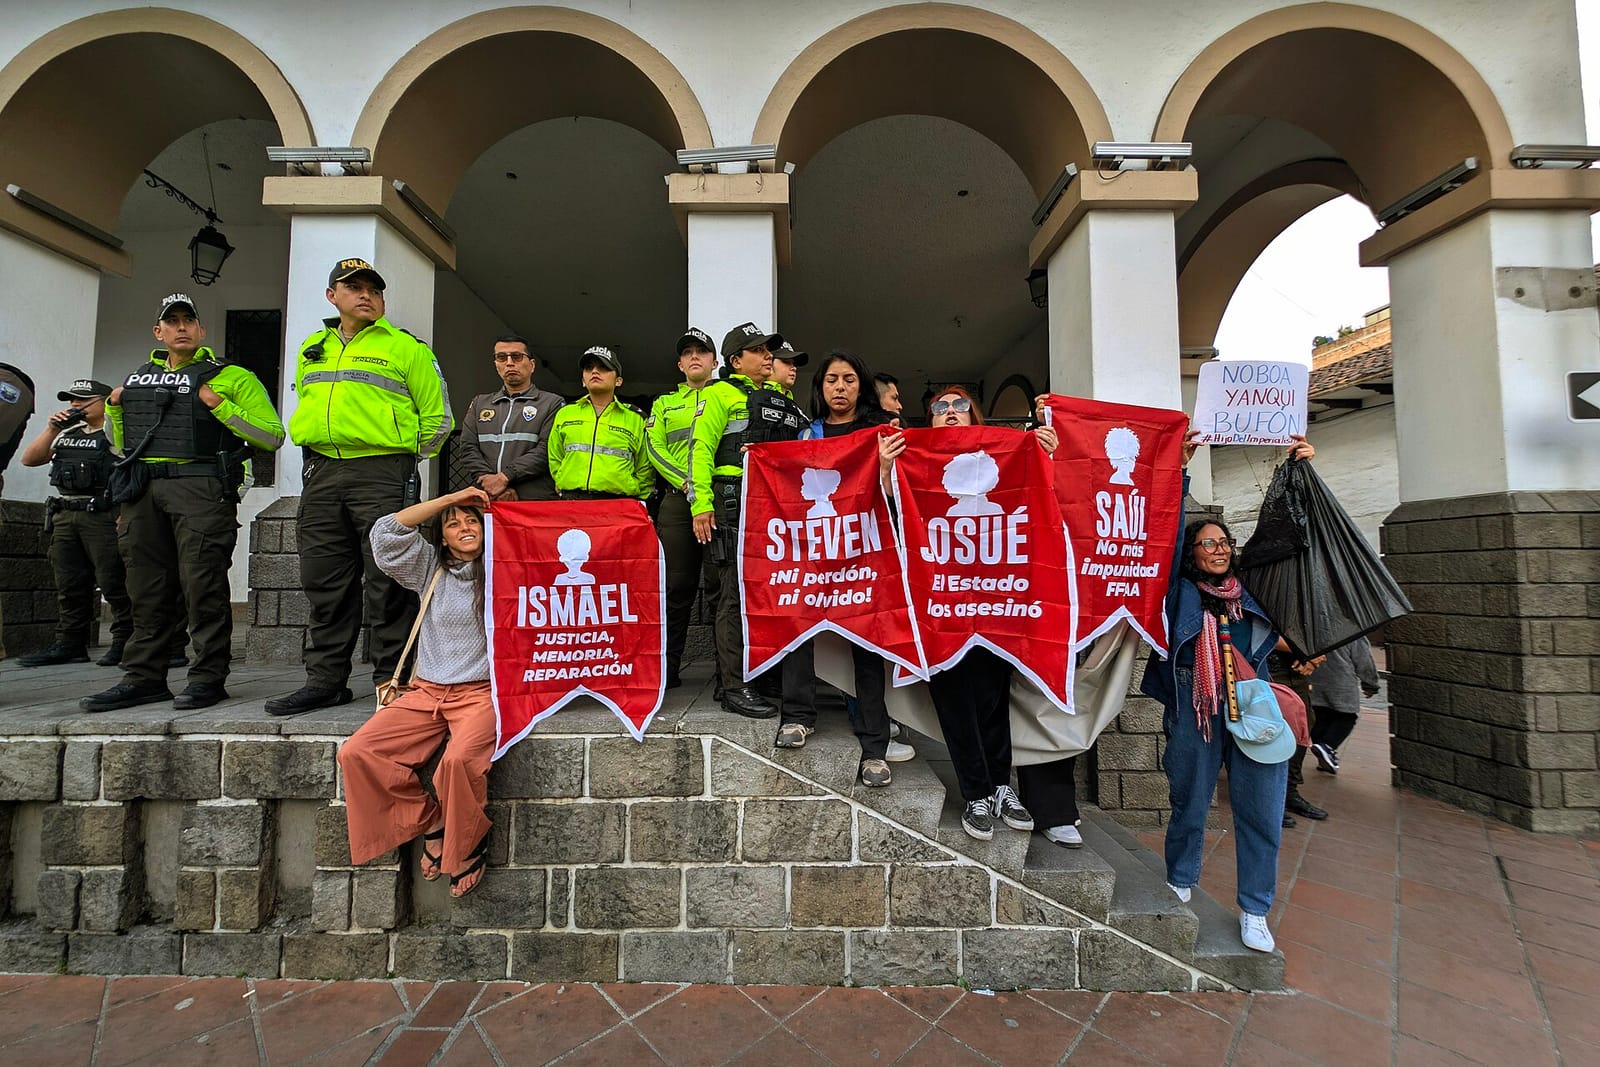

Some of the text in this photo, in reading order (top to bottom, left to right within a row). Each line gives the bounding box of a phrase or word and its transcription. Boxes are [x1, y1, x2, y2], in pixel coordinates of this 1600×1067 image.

[1222, 364, 1291, 385] NOBOA
[1225, 386, 1295, 407] YANQUI
[1214, 406, 1300, 436] BUFÓN
[1095, 488, 1147, 540] SAÚL
[766, 507, 882, 562] STEVEN
[1096, 539, 1118, 556] No
[769, 564, 878, 587] ¡Ni perdón,
[1081, 557, 1160, 580] impunidad
[932, 574, 1029, 592] El Estado
[1105, 581, 1140, 597] FFAA
[517, 583, 638, 627] ISMAEL
[778, 587, 872, 608] ni olvido!
[927, 598, 1043, 618] los asesinó
[534, 630, 615, 646] JUSTICIA,
[532, 647, 619, 663] MEMORIA,
[522, 661, 633, 682] REPARACIÓN
